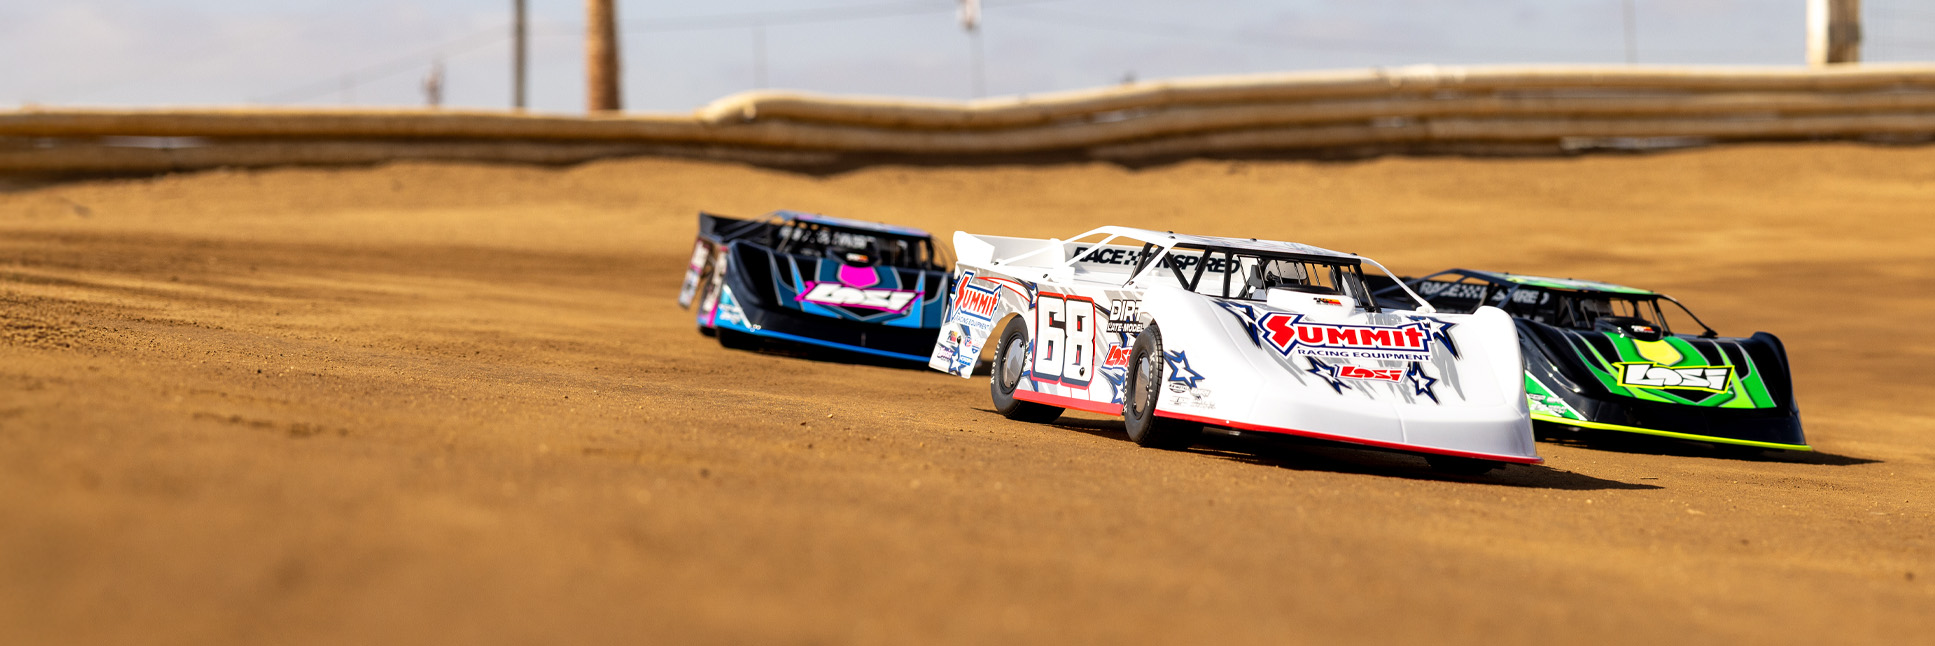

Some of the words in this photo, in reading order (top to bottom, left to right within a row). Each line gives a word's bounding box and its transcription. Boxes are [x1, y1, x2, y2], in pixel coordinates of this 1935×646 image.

[1109, 298, 1142, 322] DIRT
[1033, 295, 1094, 387] 68
[1297, 349, 1349, 358] RACING
[1353, 352, 1431, 361] EQUIPMENT
